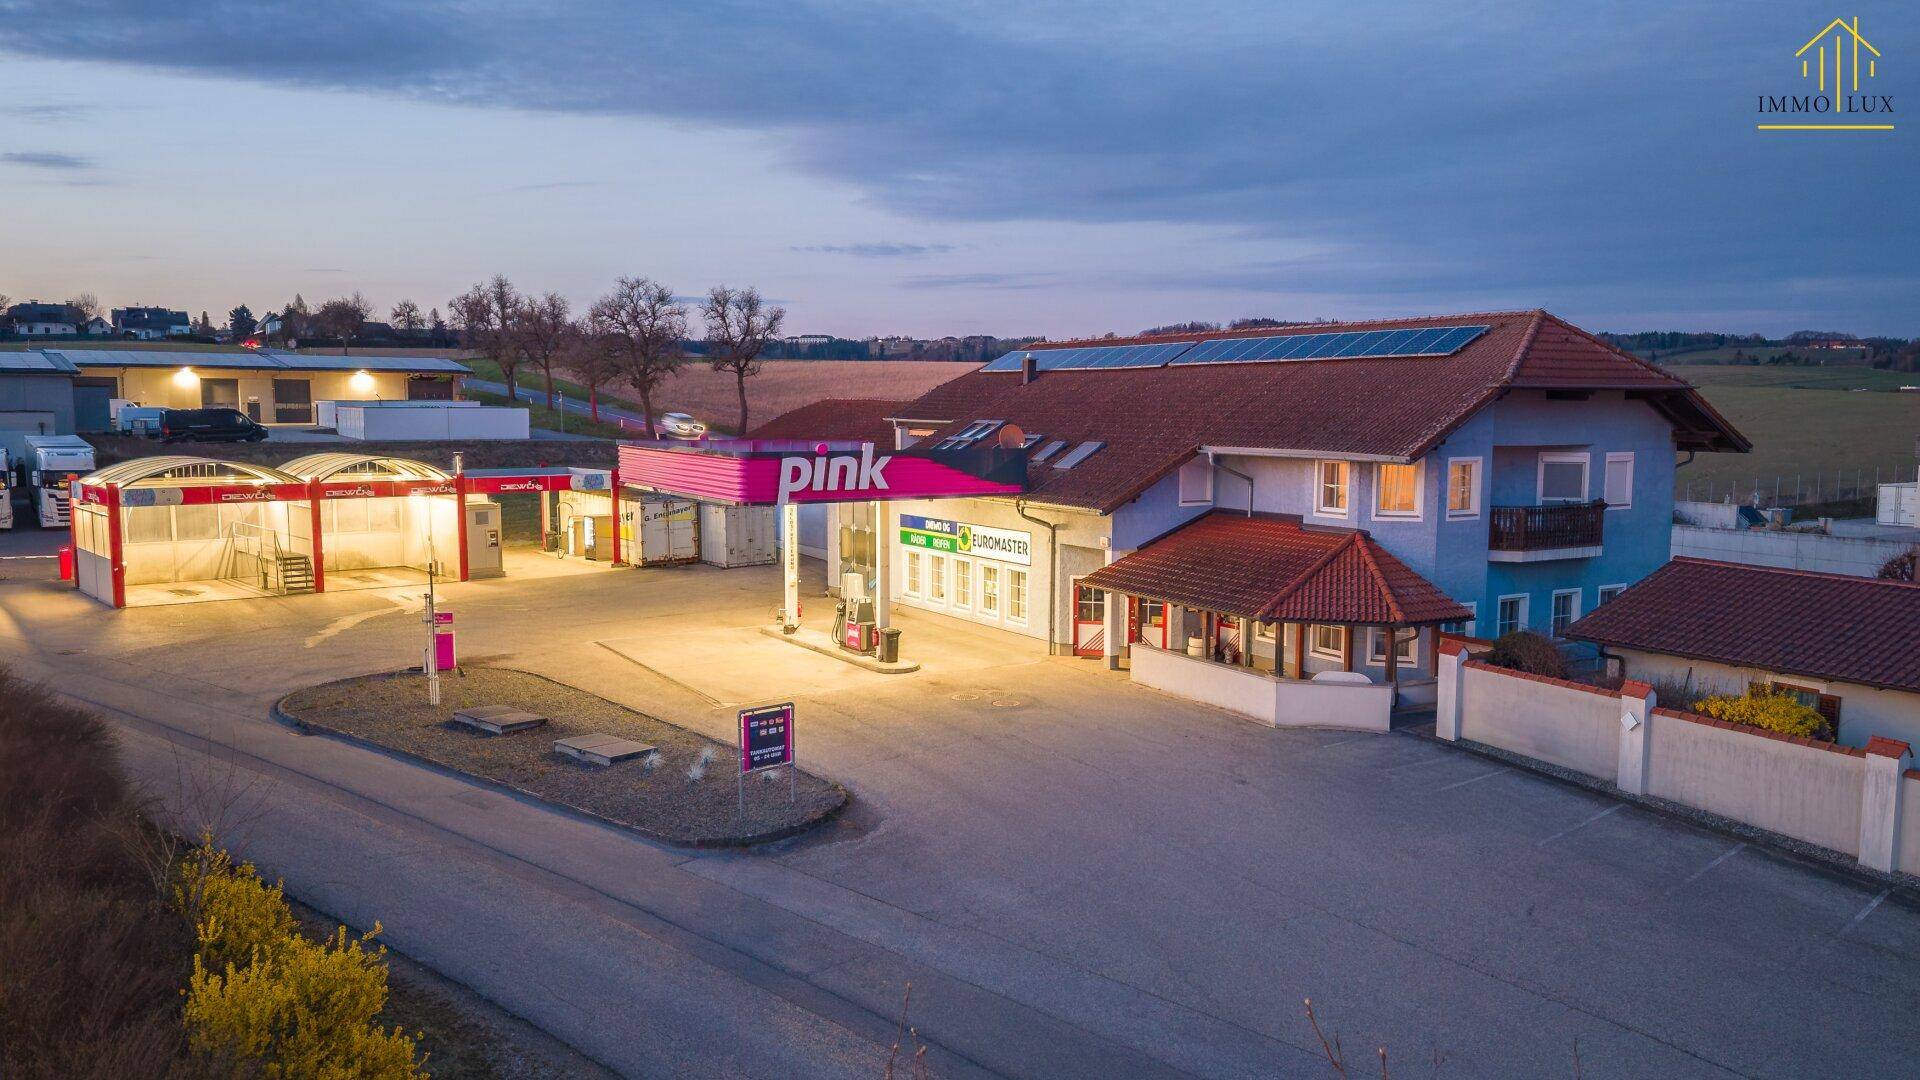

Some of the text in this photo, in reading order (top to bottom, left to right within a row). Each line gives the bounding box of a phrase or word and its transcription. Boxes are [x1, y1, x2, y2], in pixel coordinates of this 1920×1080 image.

[776, 442, 892, 507] pink
[933, 537, 950, 549] REIFEN
[972, 533, 1028, 555] EUROMASTER
